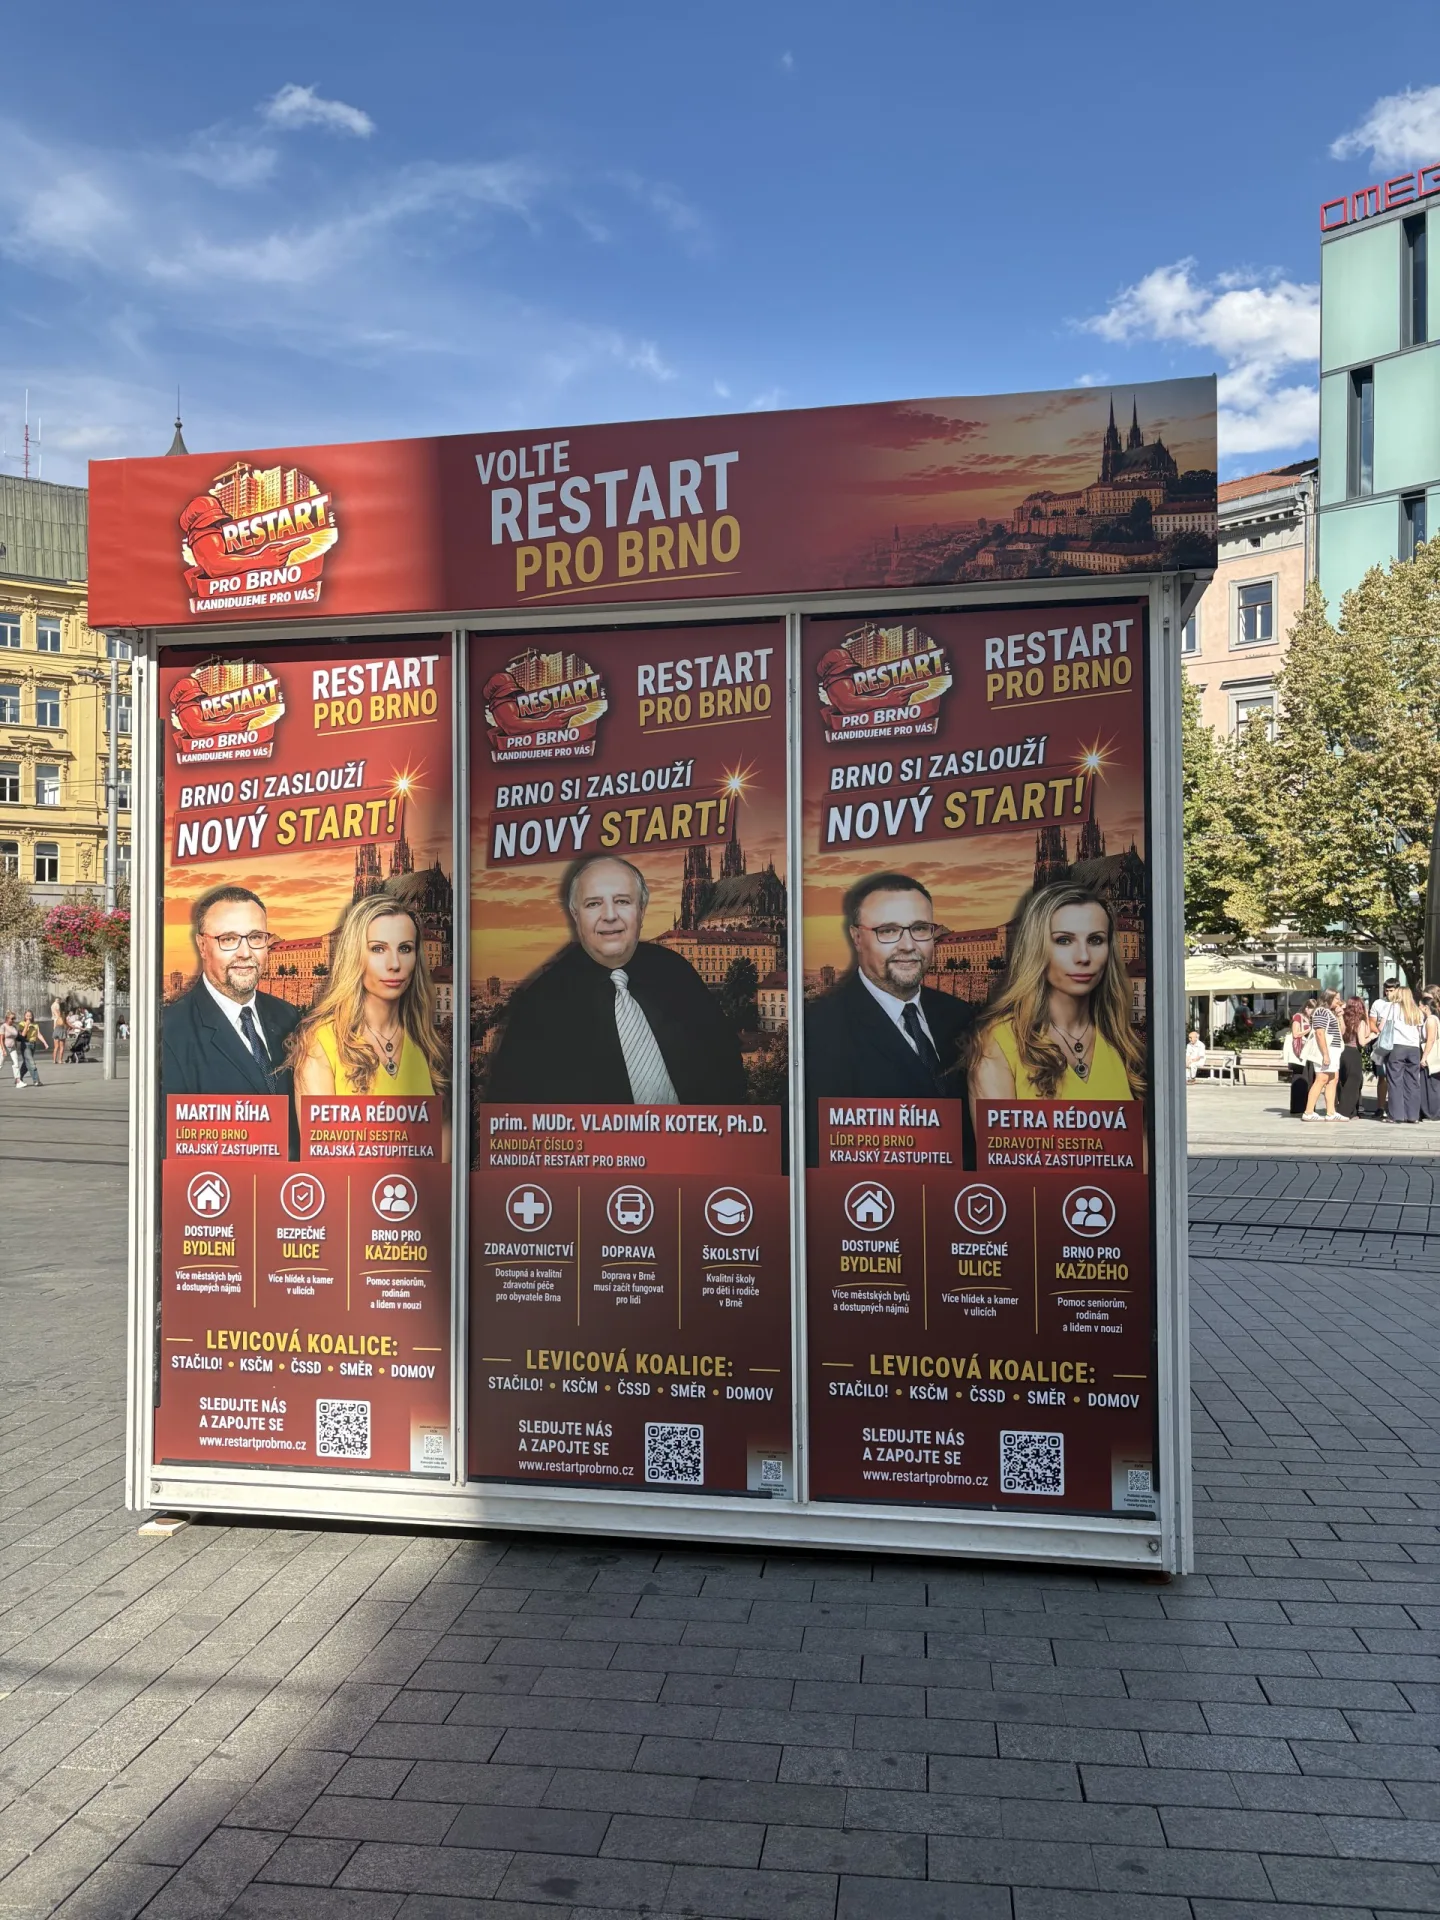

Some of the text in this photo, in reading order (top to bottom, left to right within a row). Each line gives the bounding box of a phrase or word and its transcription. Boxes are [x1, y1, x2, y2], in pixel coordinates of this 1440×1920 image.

[475, 440, 569, 485] VOLTE
[491, 451, 739, 545] RESTART
[222, 495, 328, 552] RESTART
[516, 515, 740, 591] PRO BRNO
[209, 566, 301, 594] PRO BRNO
[197, 588, 314, 610] KANDIDUJEME PRO VÁS
[985, 619, 1134, 670] RESTART
[313, 655, 439, 700] RESTART
[638, 648, 773, 696] RESTART
[987, 656, 1132, 701] PRO BRNO
[314, 688, 437, 729] PRO BRNO
[640, 684, 771, 726] PRO BRNO
[831, 736, 1047, 790] BRNO SI ZASLOUŽÍ
[181, 761, 365, 808] BRNO SI ZASLOUŽÍ
[496, 760, 694, 808] BRNO SI ZASLOUŽÍ
[827, 777, 1084, 843] NOVÝ START!
[177, 799, 397, 857] NOVÝ START!
[494, 799, 727, 858] NOVÝ START!
[176, 1101, 270, 1121] MARTIN ŘÍHA
[310, 1101, 429, 1122] PETRA RÉDOVÁ
[830, 1105, 940, 1127] MARTIN ŘÍHA
[988, 1106, 1126, 1129] PETRA RÉDOVÁ
[490, 1110, 767, 1135] prim. MUDr. VLADIMÍR KOTEK, Ph.D.
[490, 1137, 583, 1151] KANDIDÁT ČÍSLO 3
[830, 1132, 914, 1147] LÍDR PRO BRNO
[988, 1134, 1103, 1150] ZDRAVOTNÍ SESTRA
[490, 1153, 646, 1167] KANDIDÁT RESTART PRO BRNO
[830, 1148, 952, 1164] KRAJSKÝ ZASTUPITEL
[988, 1151, 1133, 1167] KRAJSKÁ ZASTUPITELKA
[185, 1224, 233, 1237] DOSTUPNÉ
[277, 1226, 325, 1240] BEZPEČNÉ
[372, 1230, 421, 1242] BRNO PRO
[183, 1239, 235, 1257] BYDLENÍ
[283, 1244, 319, 1259] ULICE
[365, 1242, 427, 1261] KAŽDÉHO
[484, 1242, 574, 1257] ZDRAVOTNICTVÍ
[602, 1246, 655, 1259] DOPRAVA
[702, 1246, 759, 1261] ŠKOLSTVÍ
[842, 1239, 900, 1253] DOSTUPNÉ
[951, 1242, 1008, 1257] BEZPEČNÉ
[1063, 1246, 1121, 1259] BRNO PRO
[841, 1255, 902, 1274] BYDLENÍ
[958, 1260, 1001, 1277] ULICE
[1055, 1261, 1128, 1280] KAŽDÉHO
[496, 1268, 528, 1280] Dostupná
[536, 1269, 562, 1279] kvalitní
[602, 1271, 630, 1282] Doprava
[639, 1272, 655, 1280] Brně
[706, 1273, 755, 1286] Kvalitní školy
[503, 1280, 554, 1292] zdravotní péče
[594, 1282, 664, 1296] musí začít fungovat
[702, 1286, 760, 1297] pro děti i rodiče
[496, 1292, 561, 1303] pro obyvatele Brna
[616, 1295, 641, 1306] pro lidi
[726, 1298, 742, 1308] Brně
[832, 1289, 910, 1303] Více městských bytů
[942, 1293, 959, 1303] Více
[961, 1294, 984, 1304] hlídek
[994, 1295, 1018, 1305] kamer
[1057, 1298, 1127, 1310] Pomoc seniorům,
[840, 1302, 883, 1314] dostupných
[886, 1303, 909, 1315] nájmů
[971, 1306, 996, 1317] ulicích
[1076, 1310, 1109, 1320] rodinám
[1070, 1323, 1090, 1332] lidem
[1101, 1324, 1122, 1333] nouzi
[207, 1329, 398, 1356] LEVICOVÁ KOALICE:
[526, 1348, 733, 1377] LEVICOVÁ KOALICE:
[870, 1353, 1095, 1383] LEVICOVÁ KOALICE:
[488, 1375, 773, 1401] STAČILO! KSČM ČSSD SMĚR DOMOV
[829, 1381, 1139, 1408] STAČILO! KSČM ČSSD SMĚR DOMOV
[519, 1420, 612, 1437] SLEDUJTE NÁS
[863, 1428, 964, 1446] SLEDUJTE NÁS
[200, 1436, 306, 1451] www.restartprobrno.cz
[519, 1438, 609, 1456] A ZAPOJTE SE
[863, 1448, 961, 1465] A ZAPOJTE SE
[518, 1460, 634, 1476] www.restartprobrno.cz
[863, 1470, 988, 1486] www.restartprobrno.cz
